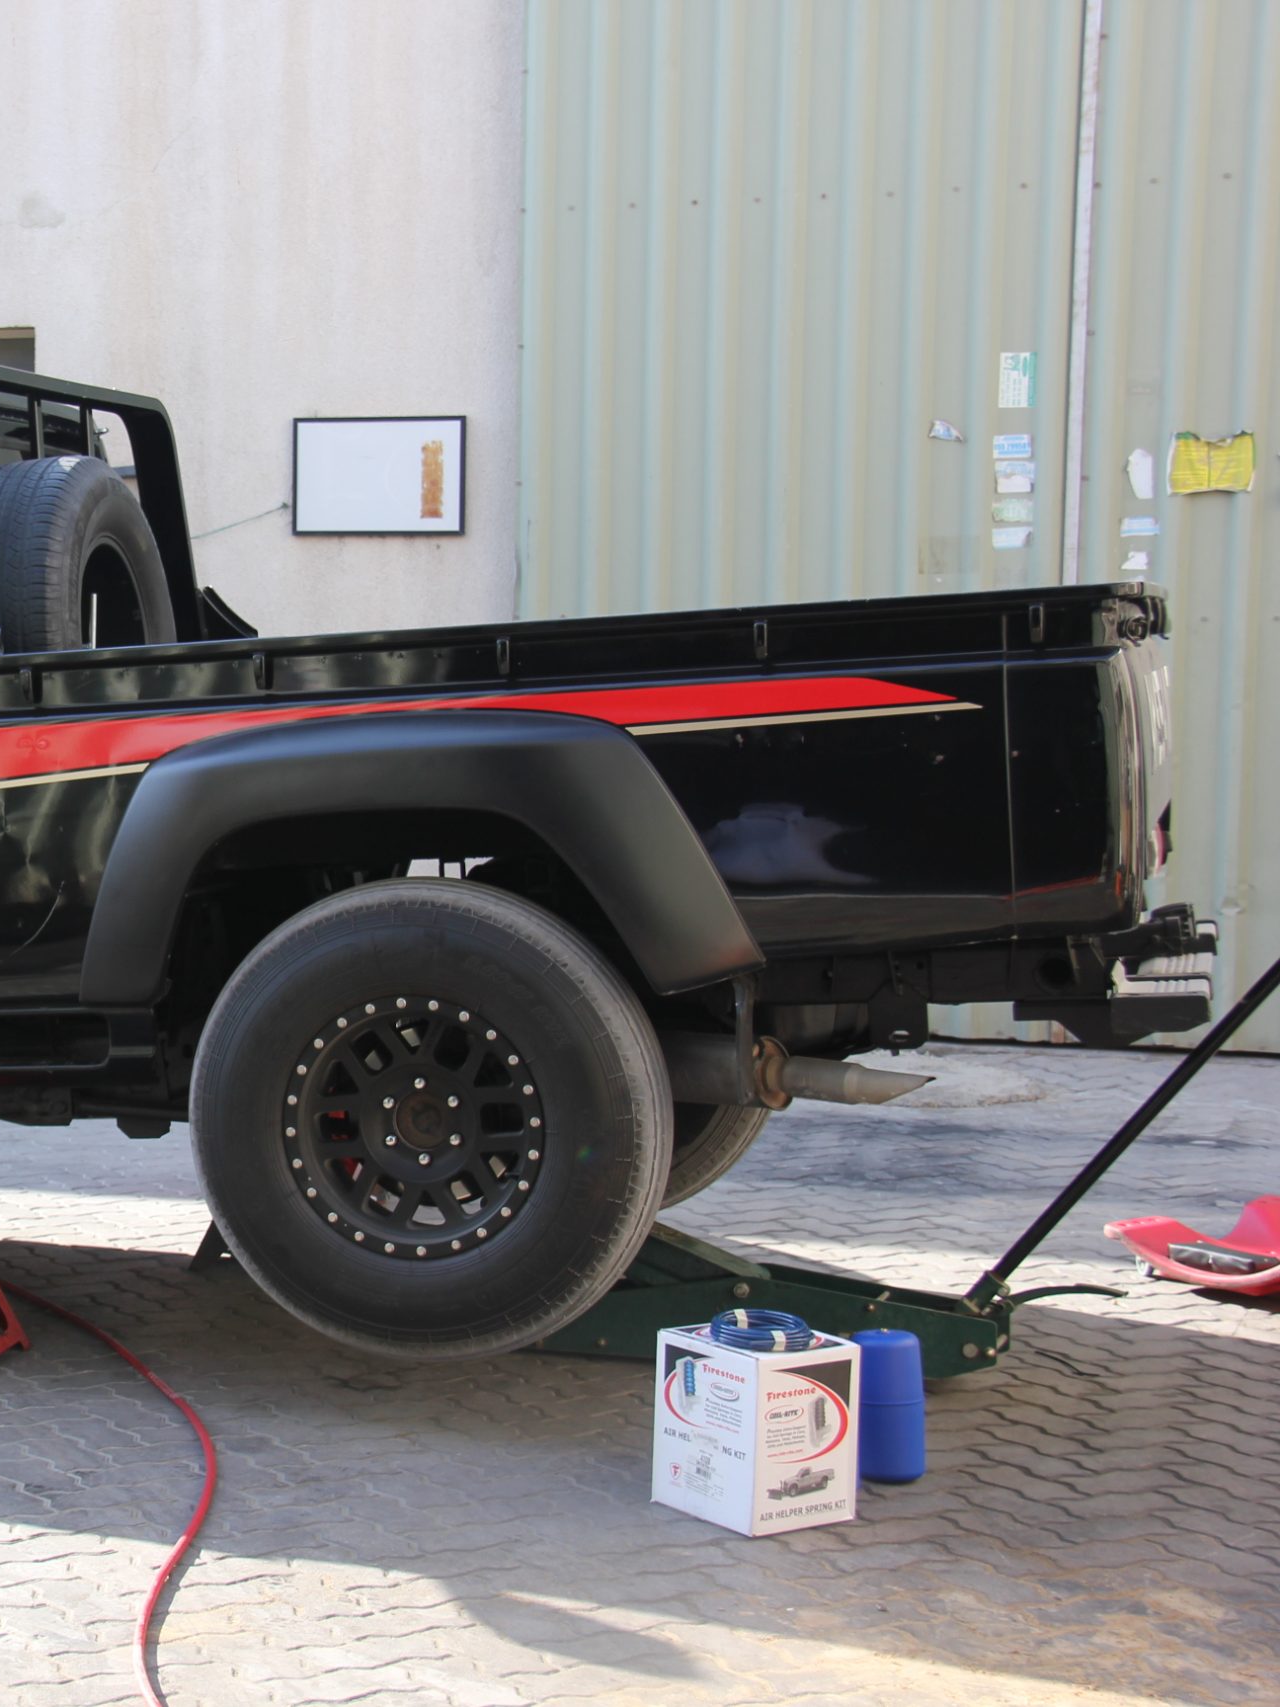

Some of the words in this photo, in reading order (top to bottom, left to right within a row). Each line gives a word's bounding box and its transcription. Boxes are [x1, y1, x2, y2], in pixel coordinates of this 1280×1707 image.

[702, 1363, 746, 1384] Firestone
[766, 1387, 817, 1402] Firestone
[664, 1427, 677, 1437] AIR
[734, 1450, 747, 1460] KIT
[760, 1512, 774, 1521] AIR
[775, 1508, 804, 1519] HELPER
[805, 1502, 833, 1514] SPRING
[834, 1499, 847, 1510] KIT
